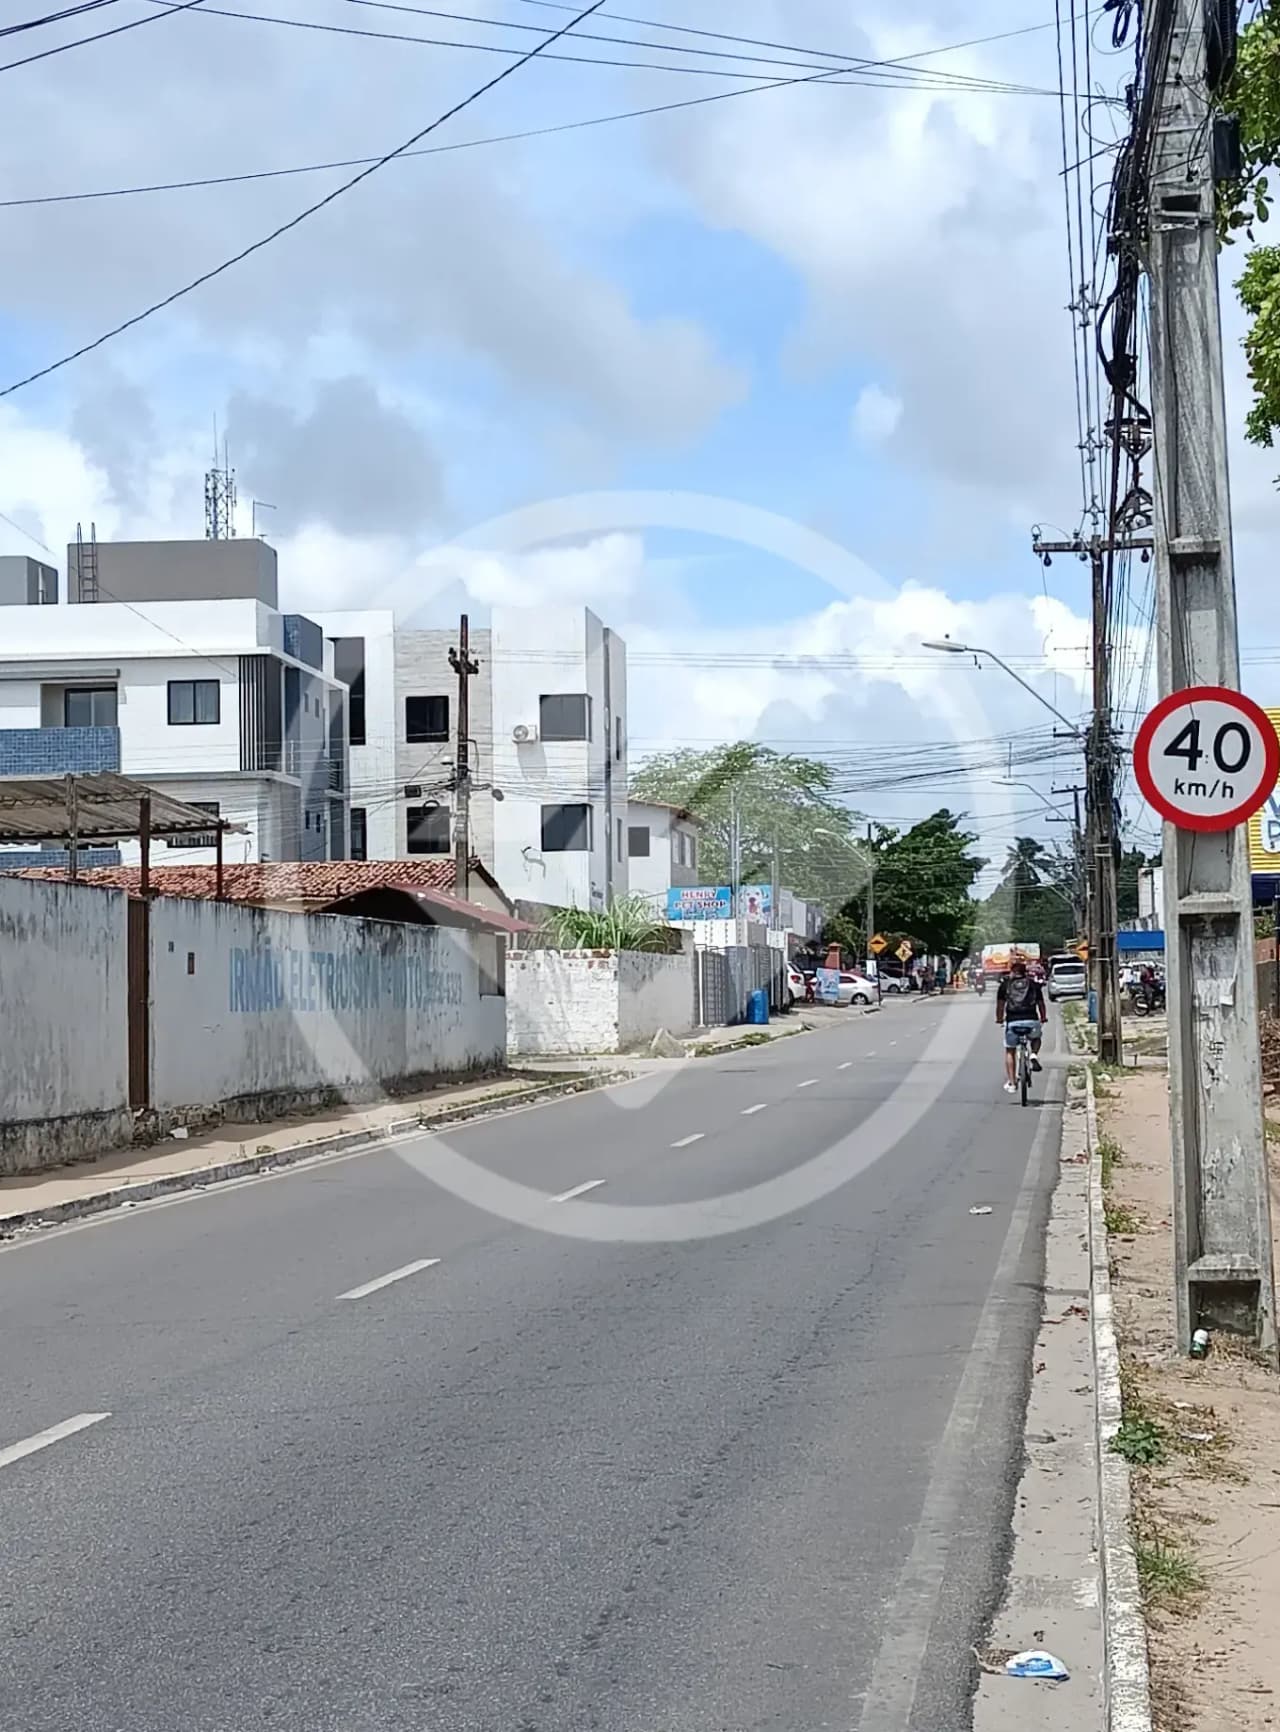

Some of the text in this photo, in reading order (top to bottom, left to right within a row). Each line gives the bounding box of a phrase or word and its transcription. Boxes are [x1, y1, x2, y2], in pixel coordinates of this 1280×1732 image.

[1163, 719, 1251, 774] 40
[1173, 778, 1234, 799] km/h
[674, 900, 726, 909] PET SHOP
